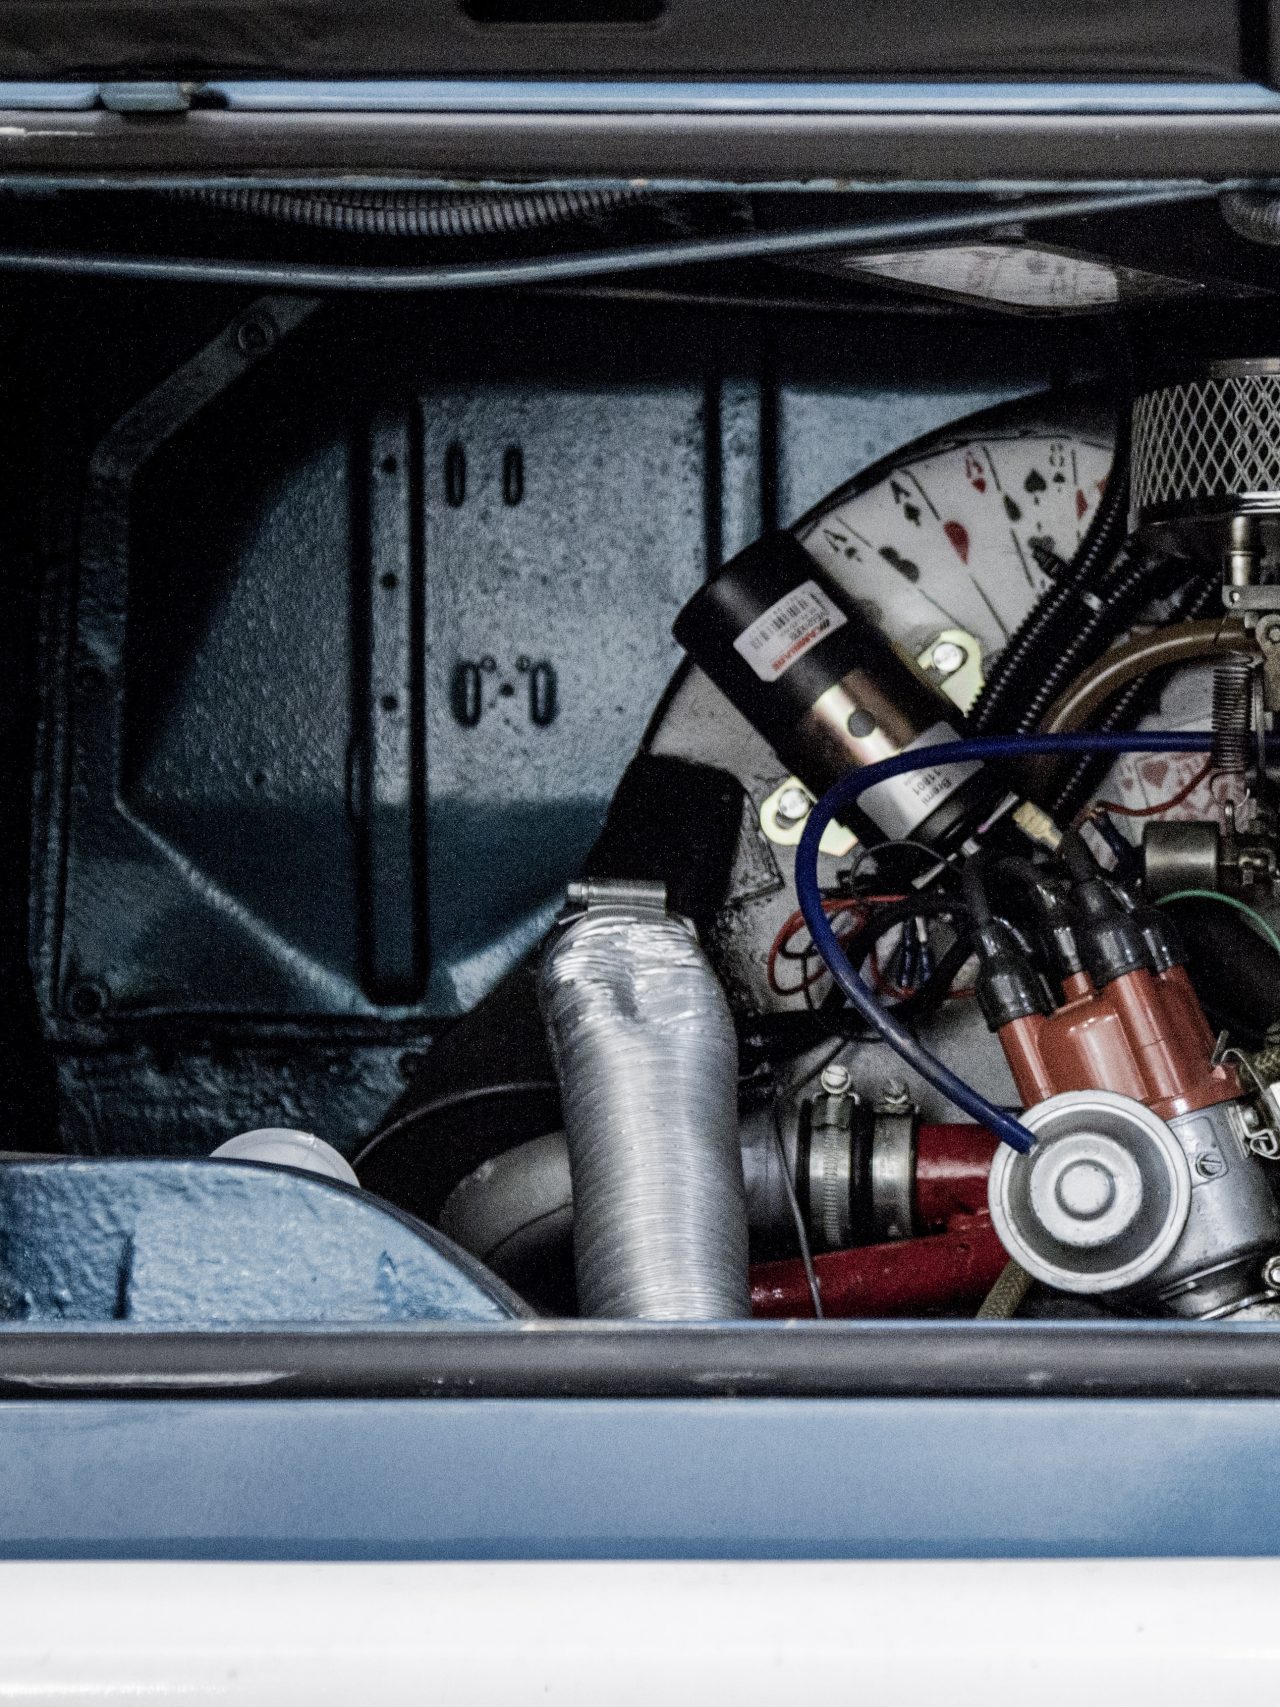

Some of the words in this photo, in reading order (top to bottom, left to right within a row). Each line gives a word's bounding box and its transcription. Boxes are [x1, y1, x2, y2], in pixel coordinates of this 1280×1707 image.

[964, 450, 984, 480] A
[890, 479, 911, 505] A
[822, 528, 848, 553] A
